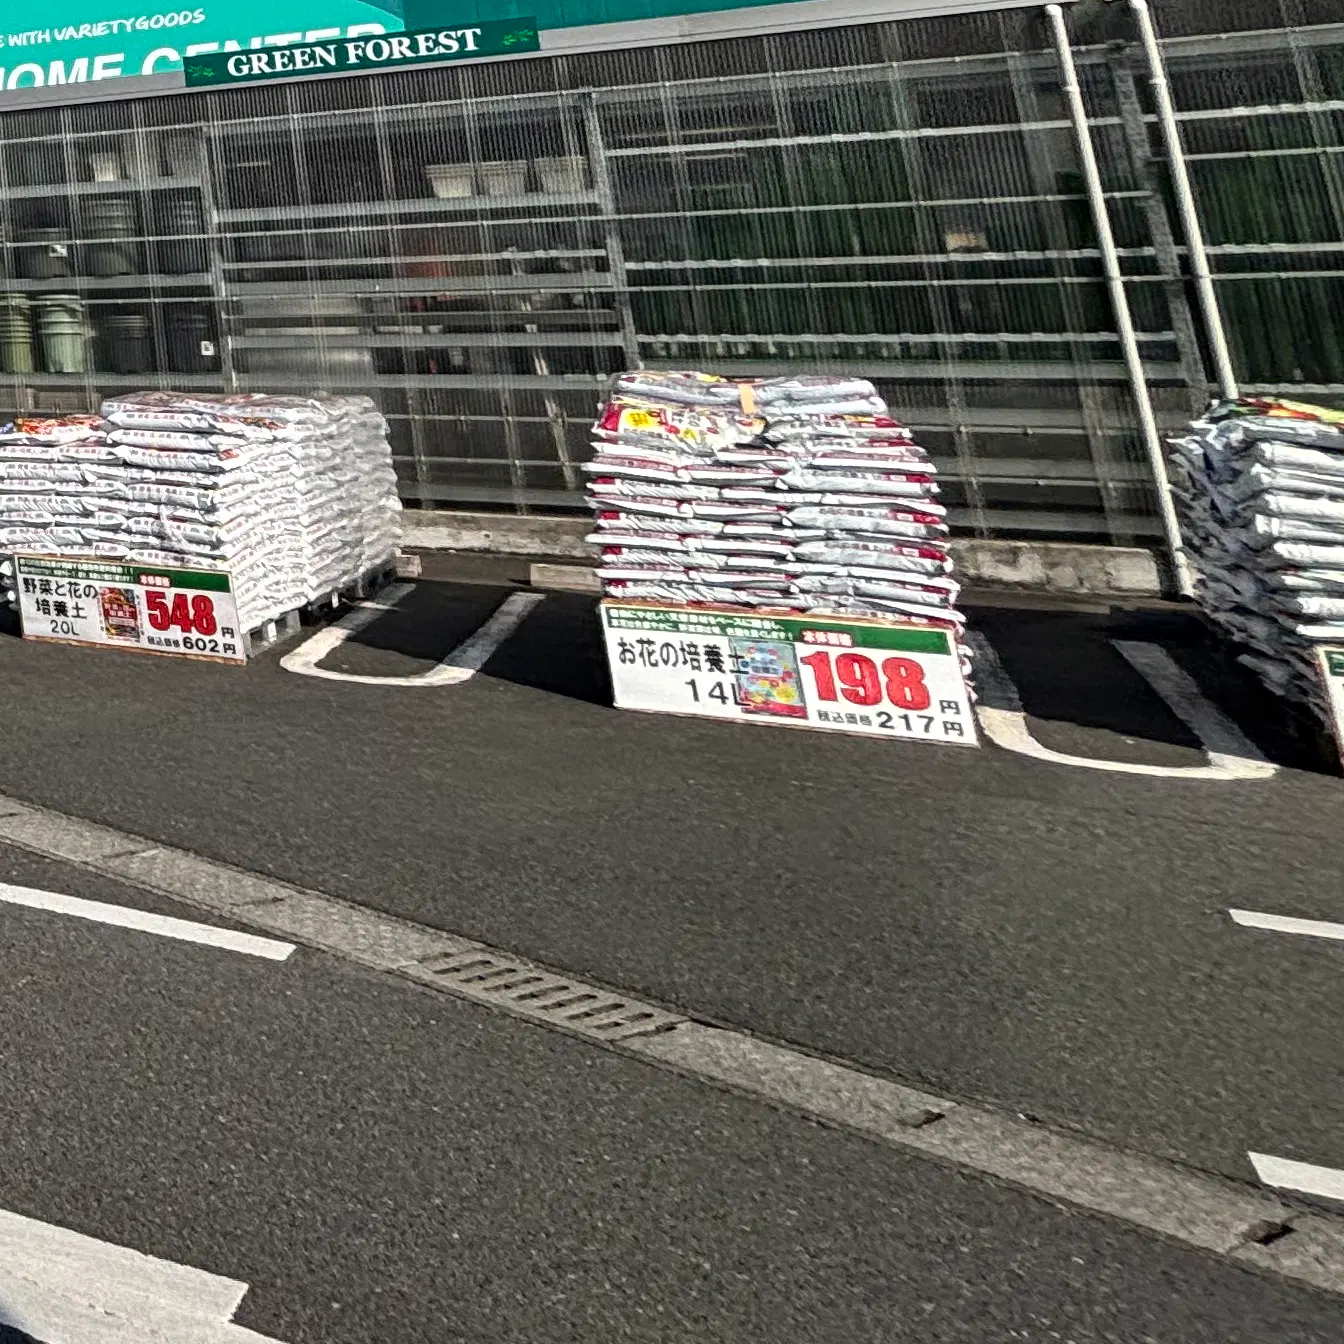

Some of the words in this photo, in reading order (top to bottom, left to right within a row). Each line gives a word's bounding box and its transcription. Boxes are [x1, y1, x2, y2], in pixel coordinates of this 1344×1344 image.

[8, 29, 50, 47] WITH
[226, 43, 340, 77] GREEN
[344, 28, 481, 64] FOREST
[23, 577, 98, 600] 野菜と花の
[35, 597, 88, 620] 培養土
[145, 590, 217, 637] 548
[50, 619, 80, 637] 20L
[617, 637, 750, 675] お花の培養土
[685, 679, 753, 707] 14L
[801, 650, 932, 712] 198
